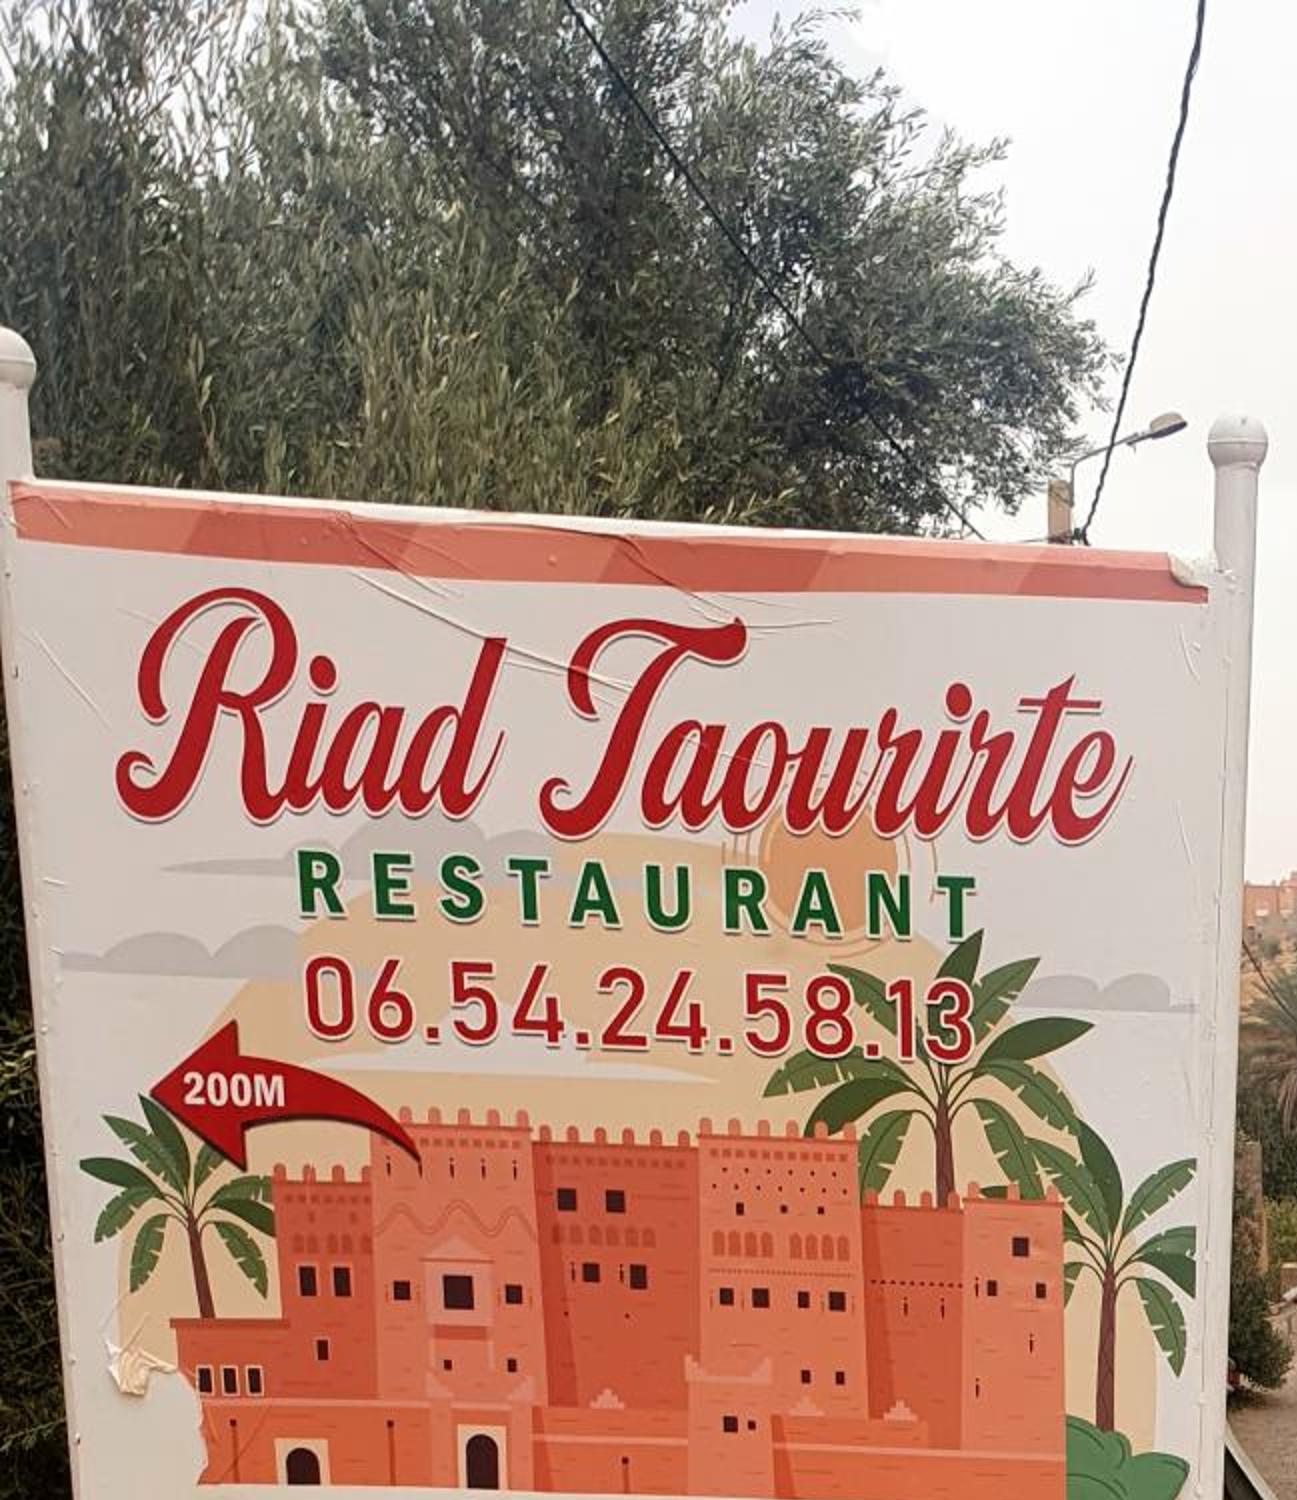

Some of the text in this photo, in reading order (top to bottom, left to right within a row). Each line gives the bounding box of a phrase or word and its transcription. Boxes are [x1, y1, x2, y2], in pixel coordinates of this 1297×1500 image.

[115, 586, 1134, 842] Riad Taourirte
[298, 849, 976, 939] RESTAURANT
[305, 956, 974, 1062] 06.54.24.58.13
[183, 1071, 286, 1107] 200M
